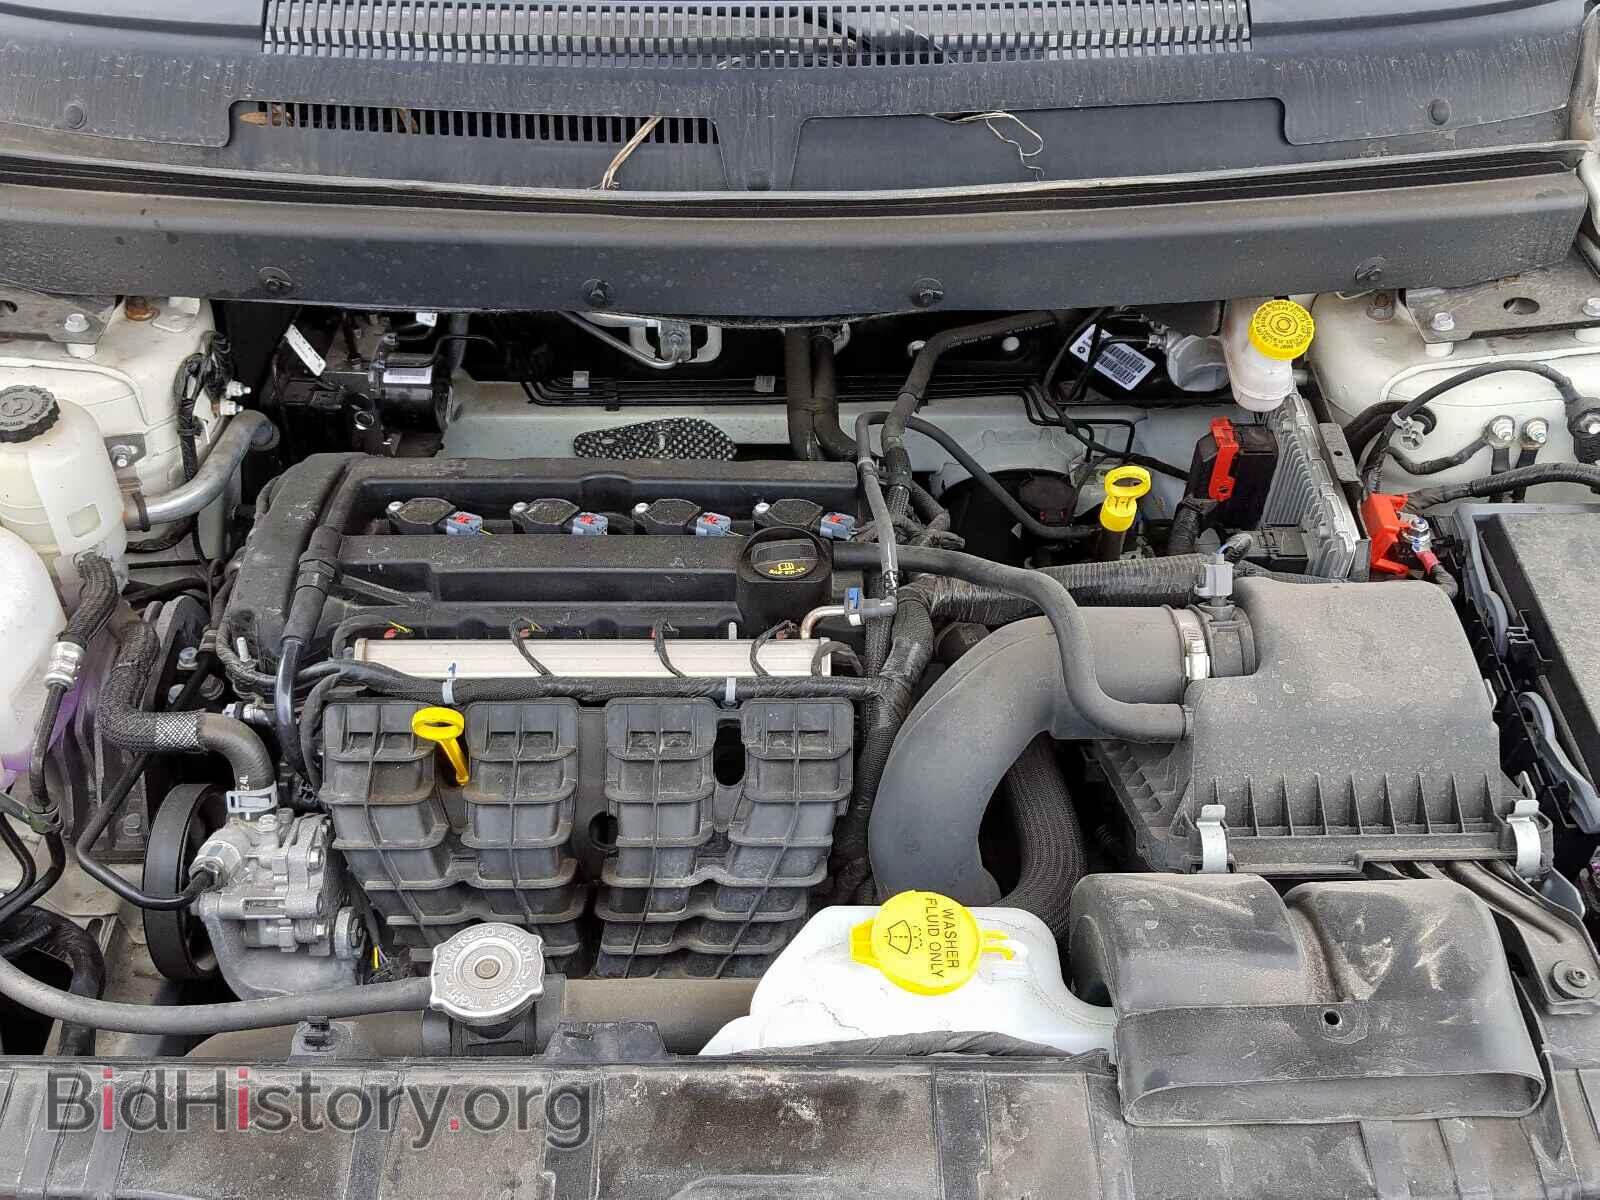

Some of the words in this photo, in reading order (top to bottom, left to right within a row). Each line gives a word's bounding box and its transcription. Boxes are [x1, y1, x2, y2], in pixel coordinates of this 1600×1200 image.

[240, 775, 250, 792] 2.4L
[925, 897, 940, 937] FLUID
[942, 908, 960, 969] WASHER
[929, 941, 945, 978] ONLY
